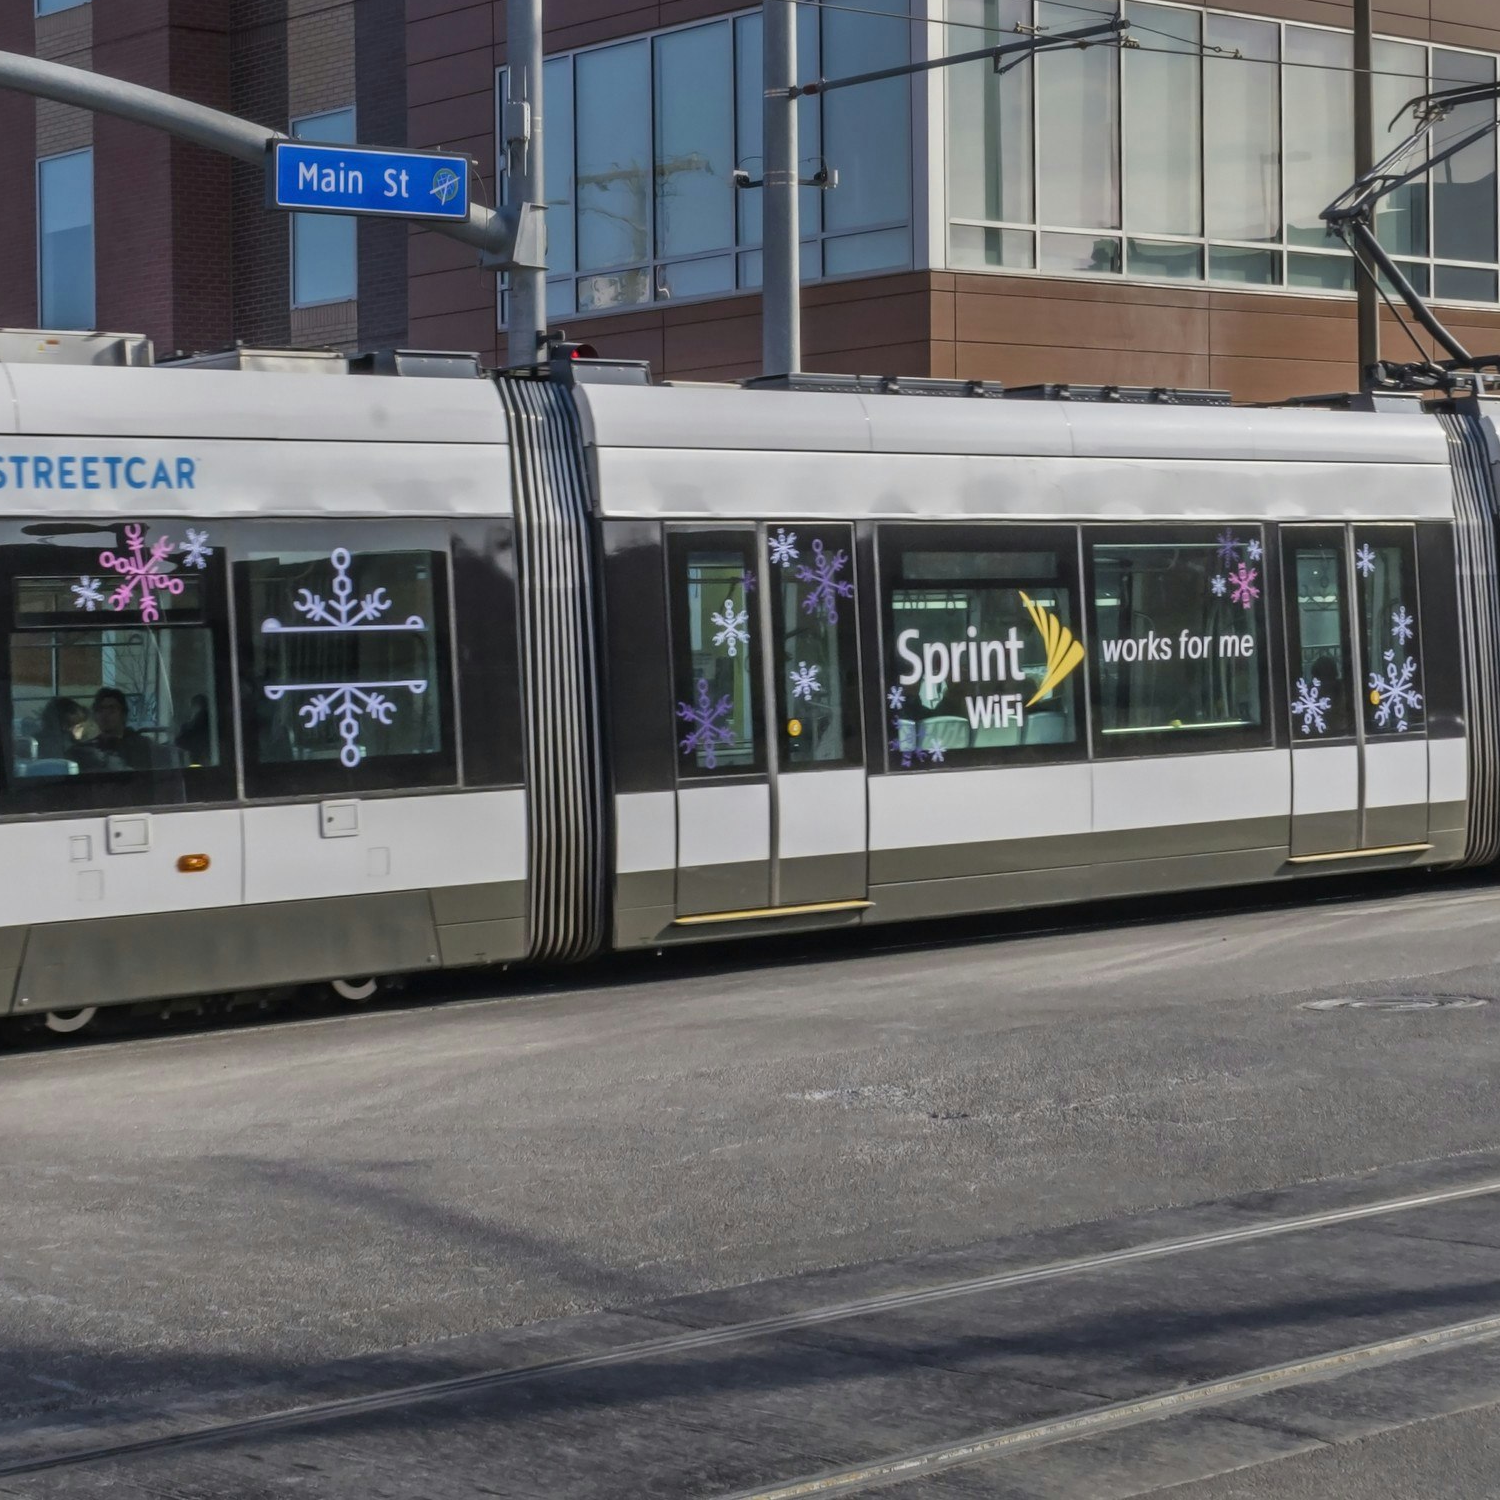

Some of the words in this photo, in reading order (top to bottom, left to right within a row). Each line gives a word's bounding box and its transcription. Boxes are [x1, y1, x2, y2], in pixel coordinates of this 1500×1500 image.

[298, 162, 363, 195] Main
[383, 168, 409, 198] St
[897, 626, 1026, 696] Sprint
[1102, 631, 1173, 662] works
[1178, 628, 1214, 659] for
[1218, 631, 1254, 658] me
[965, 694, 1025, 729] WiFi
